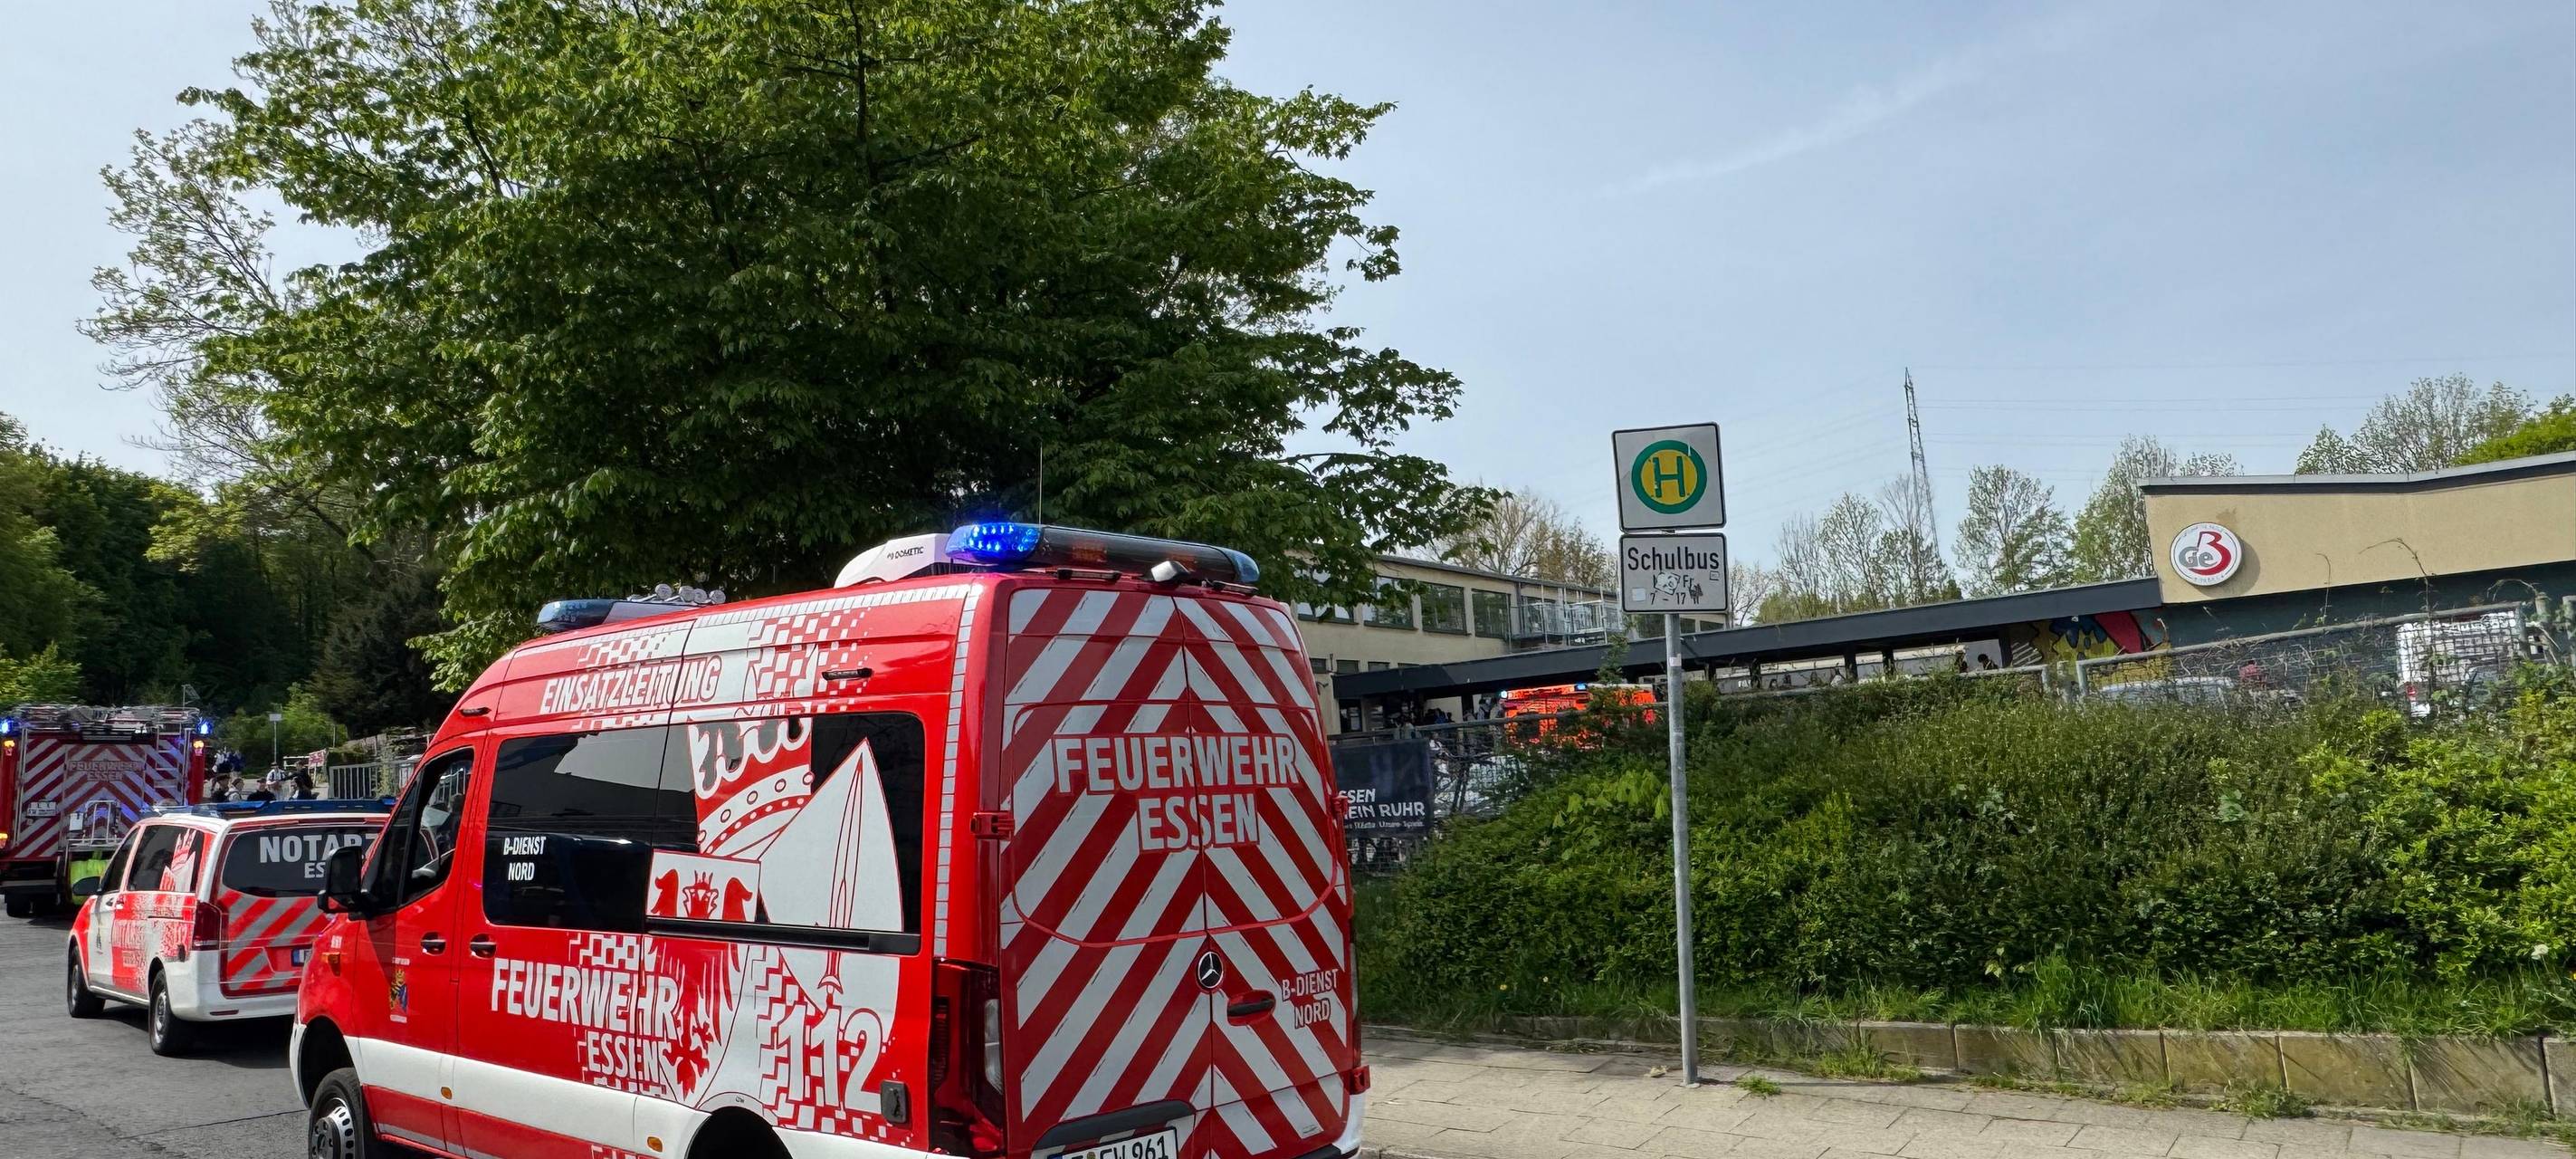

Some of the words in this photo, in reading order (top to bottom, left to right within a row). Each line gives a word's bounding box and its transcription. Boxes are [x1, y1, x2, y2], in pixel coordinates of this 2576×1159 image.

[1653, 455, 1685, 498] H
[1627, 546, 1719, 571] Schulbus
[1675, 592, 1686, 605] 17
[539, 656, 722, 714] EINSATZLEITUNG
[1054, 734, 1301, 793] FEUERWEHR
[1339, 788, 1376, 803] SSEN
[1379, 801, 1426, 817] RUHR
[1138, 793, 1258, 850] ESSEN
[503, 836, 547, 856] B-DIENST
[508, 862, 535, 881] NORD
[491, 957, 679, 1040] FEUERWEHR
[1282, 968, 1339, 1001] B-DIENST
[1294, 999, 1331, 1029] NORD
[587, 1030, 663, 1083] ESSEN
[777, 1002, 883, 1114] 112
[1131, 1135, 1169, 1159] 961
